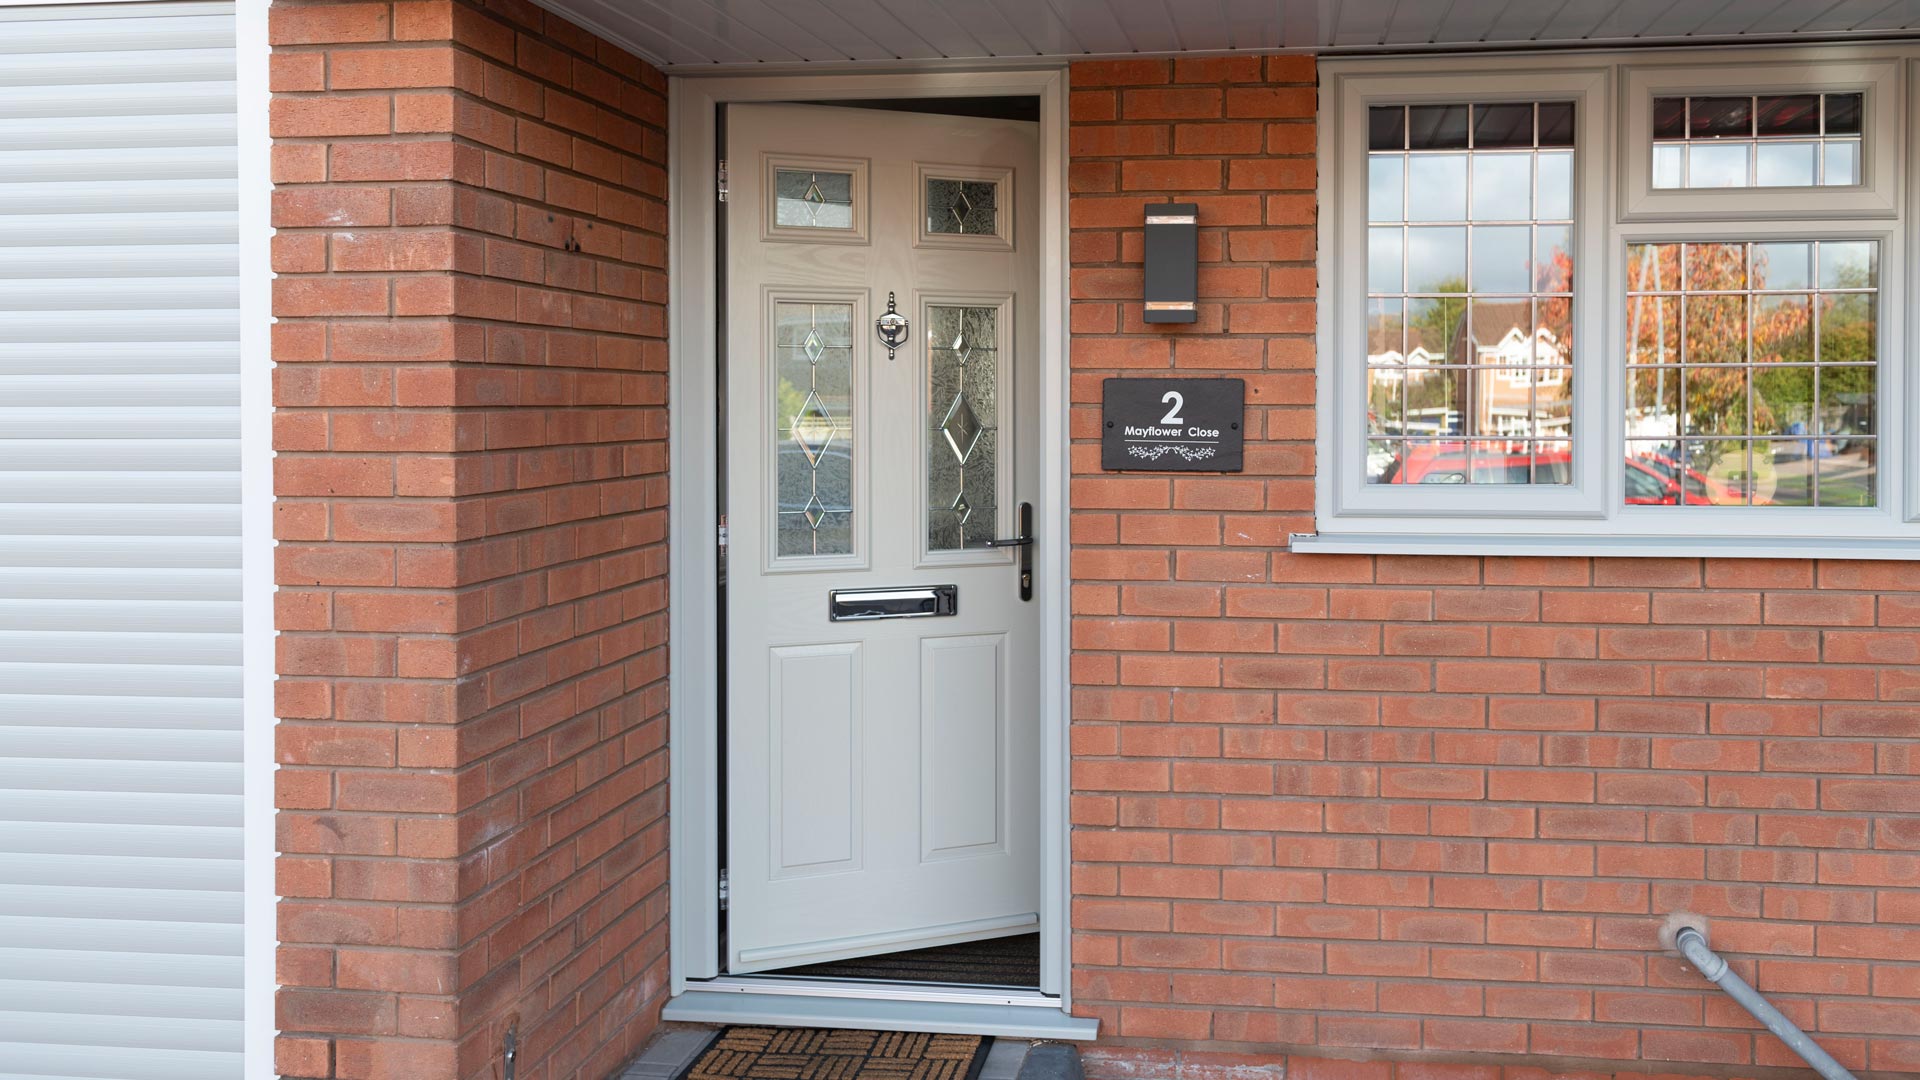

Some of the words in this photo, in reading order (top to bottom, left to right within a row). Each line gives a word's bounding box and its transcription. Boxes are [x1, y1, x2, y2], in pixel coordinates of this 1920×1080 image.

[1160, 391, 1184, 425] 2
[1124, 426, 1183, 438] Mayflower
[1187, 427, 1220, 438] Close
